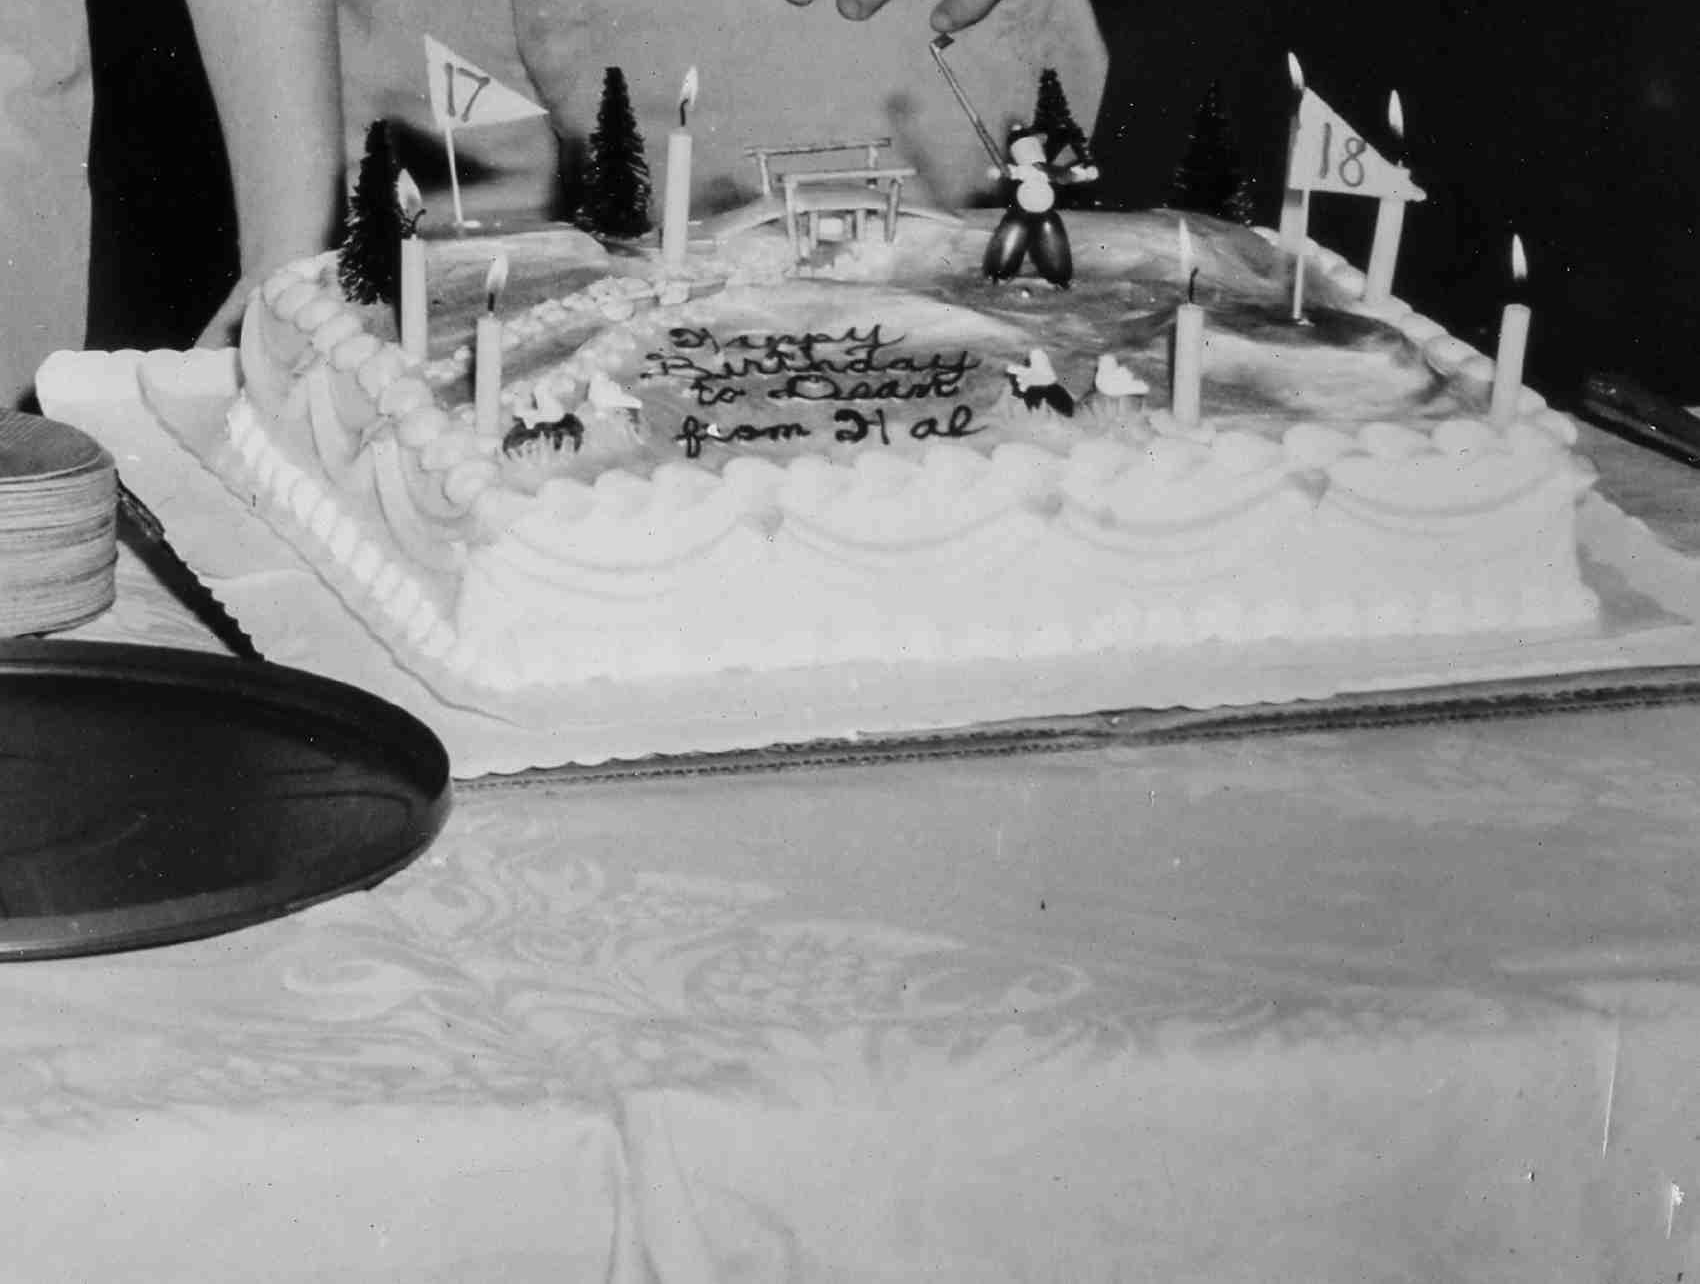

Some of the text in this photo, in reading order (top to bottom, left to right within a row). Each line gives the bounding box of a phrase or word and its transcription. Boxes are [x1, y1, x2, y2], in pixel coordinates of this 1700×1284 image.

[443, 62, 492, 123] 17
[1318, 122, 1367, 188] 18
[668, 324, 905, 362] Happy
[640, 350, 984, 384] Birthday
[691, 373, 961, 405] to Dean
[673, 405, 990, 458] from Hal
